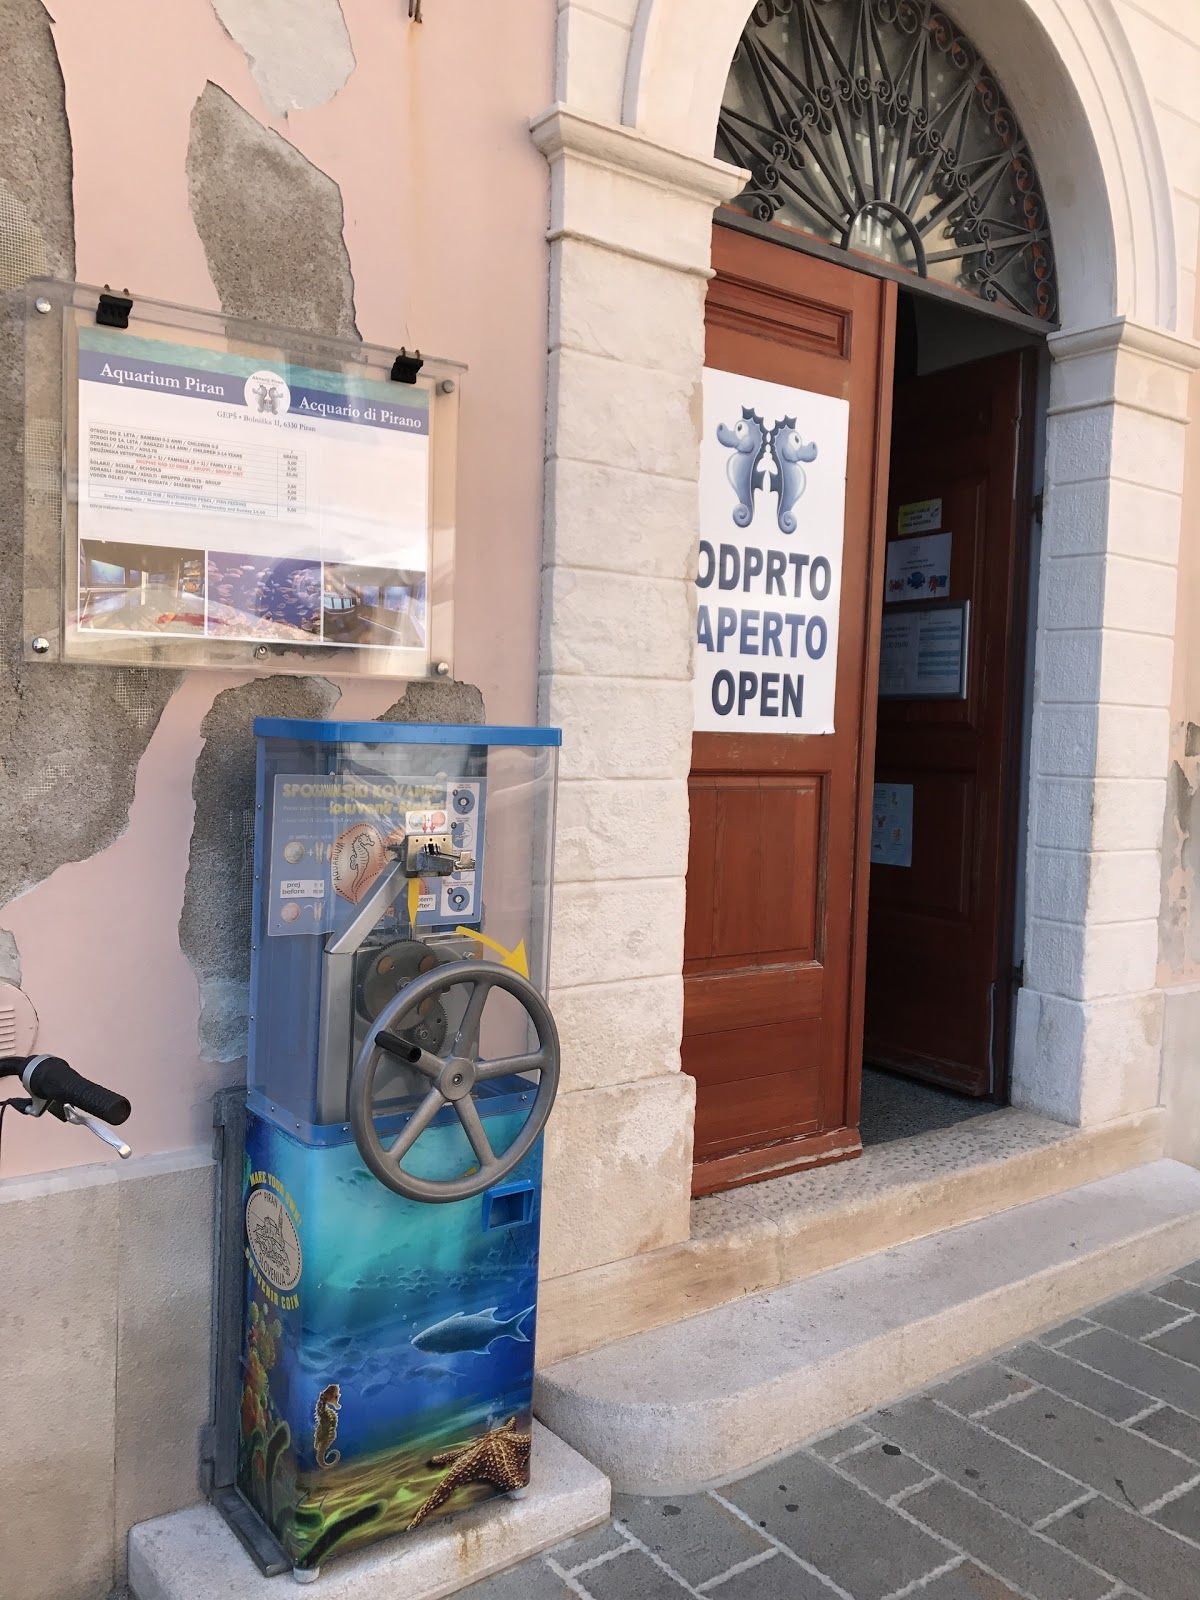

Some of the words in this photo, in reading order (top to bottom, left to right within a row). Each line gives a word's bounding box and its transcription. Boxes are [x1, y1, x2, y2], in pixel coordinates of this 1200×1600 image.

[100, 363, 180, 388] Aquarium
[185, 376, 225, 396] Piran
[299, 396, 360, 418] Acquario
[364, 407, 376, 420] di
[380, 410, 422, 428] Pirano
[299, 423, 316, 432] Piran
[695, 540, 832, 601] ODPRTO
[697, 604, 828, 660] APERTO
[711, 669, 804, 718] OPEN
[332, 842, 346, 881] AQUARIUM
[264, 1192, 278, 1208] PIRAN
[258, 1252, 286, 1286] SLOVENIJA
[281, 1294, 300, 1310] COIN
